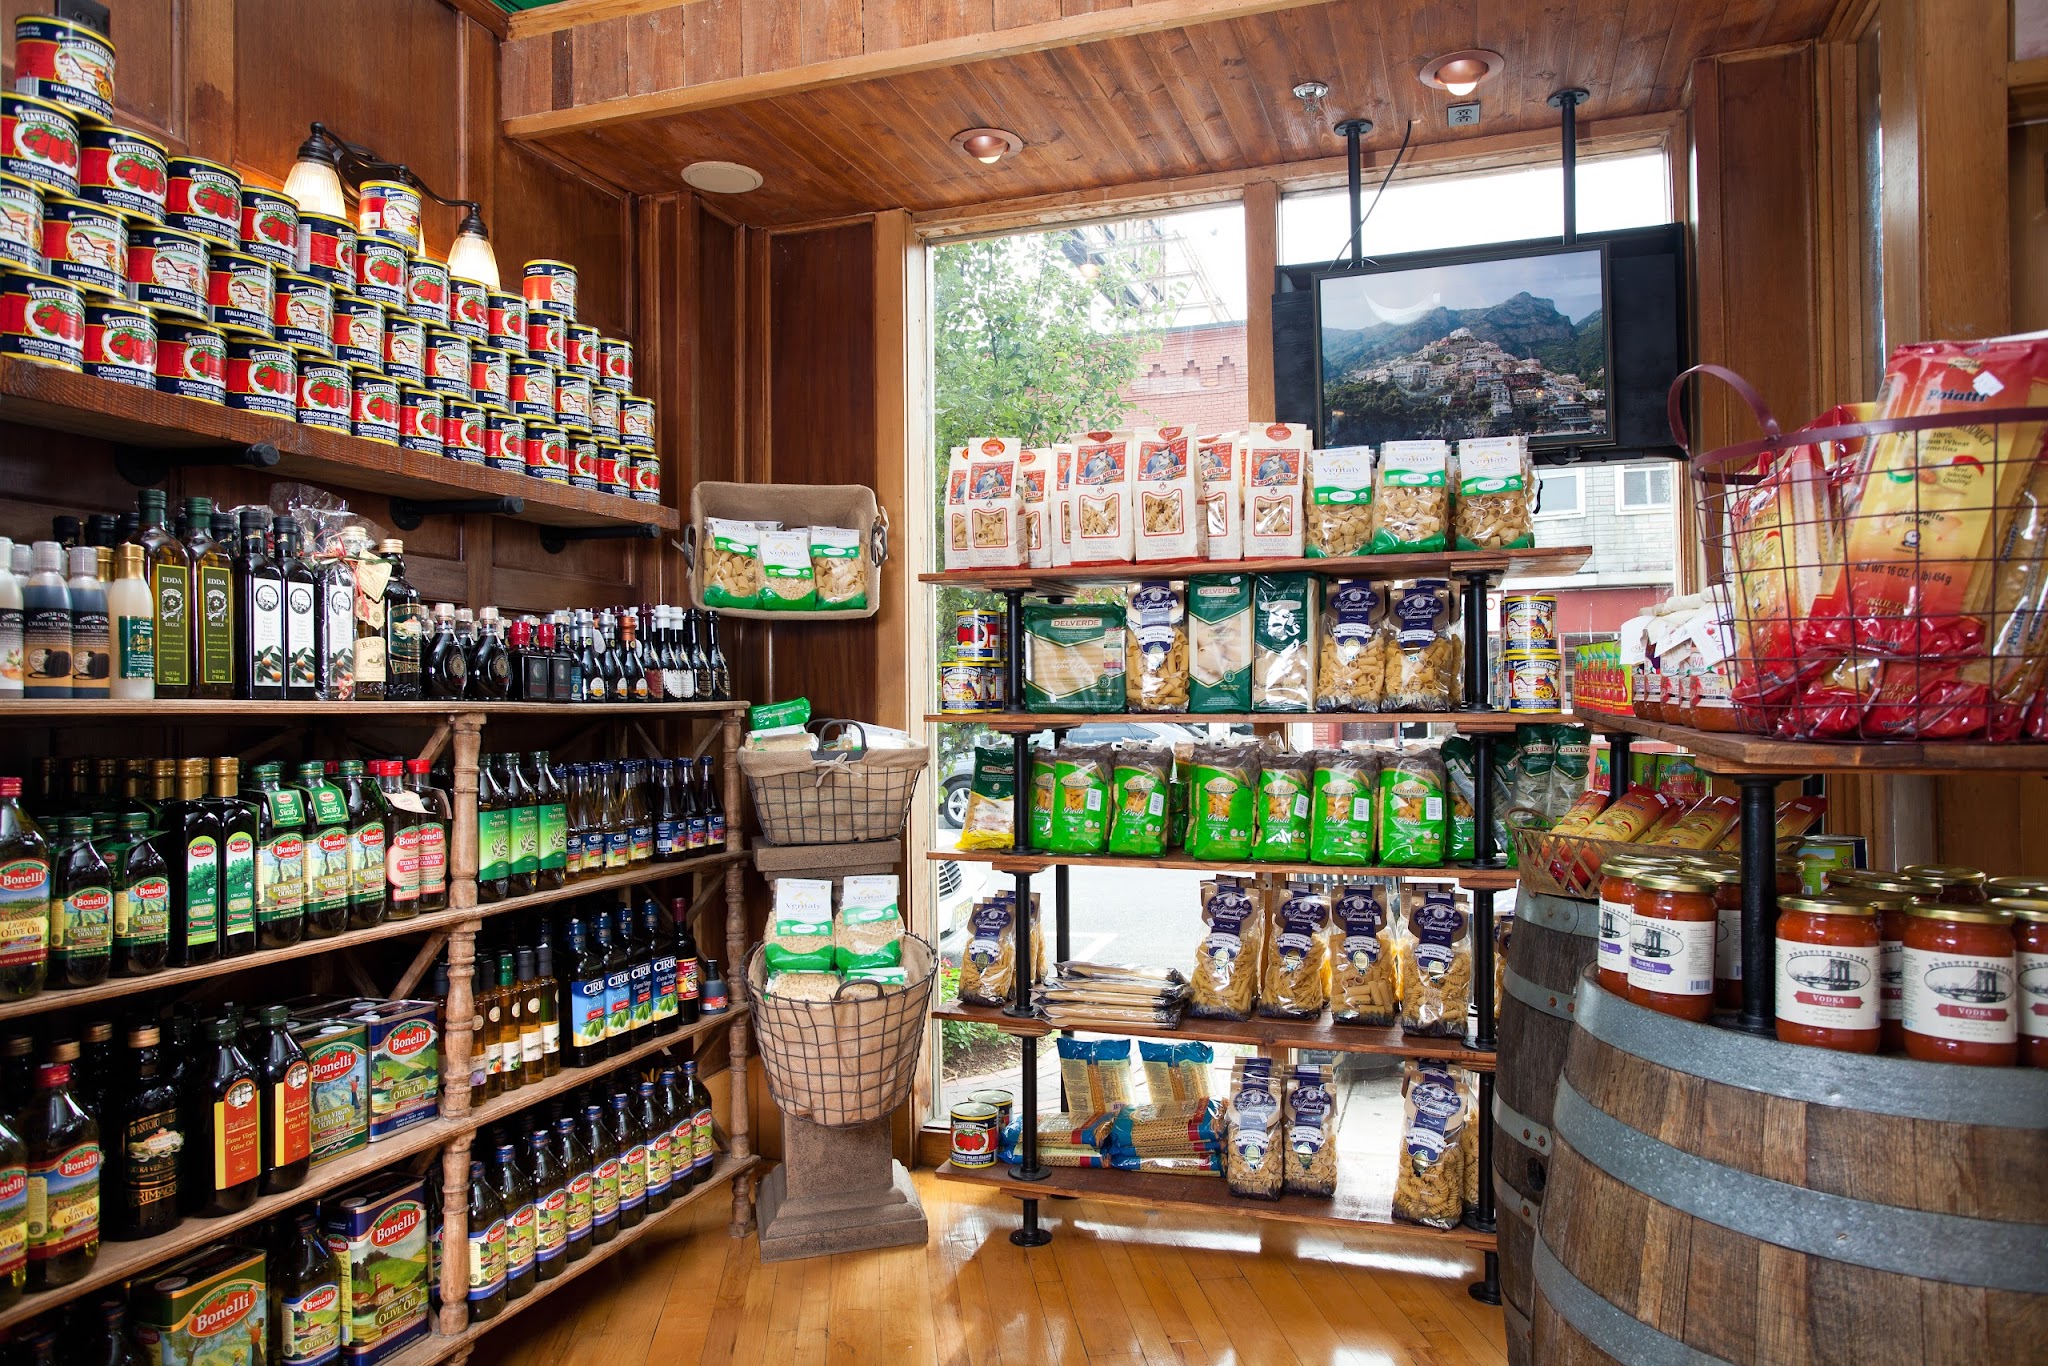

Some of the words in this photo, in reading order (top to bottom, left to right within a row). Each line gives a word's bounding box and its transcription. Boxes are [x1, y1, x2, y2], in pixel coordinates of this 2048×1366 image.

[20, 113, 70, 129] FRANCESCONI
[112, 144, 159, 161] FRANCESCONI
[8, 159, 51, 174] POMODORI
[193, 173, 235, 189] FRANCESCONI
[102, 189, 141, 203] POMODORI
[107, 200, 121, 208] PESO
[122, 203, 139, 212] NETTO
[62, 263, 91, 276] ITALIAN
[91, 268, 113, 280] PEELED
[148, 286, 174, 297] ITALIAN
[360, 286, 389, 297] POMODORI
[224, 309, 249, 320] ITALIAN
[24, 349, 39, 357] PESO
[40, 351, 59, 360] NETTO
[178, 380, 213, 391] POMODORI
[1926, 388, 1988, 402] Poiatti
[299, 410, 330, 420] POMODORI
[1956, 424, 1993, 447] RODUCT
[1944, 439, 1970, 447] Wheat
[1322, 466, 1361, 477] Veritaly
[162, 576, 182, 585] EDDA
[1855, 564, 1870, 573] NET
[1871, 565, 1884, 574] WT.
[1887, 566, 1896, 575] 16
[1932, 571, 1945, 582] 454
[1945, 575, 1952, 586] g
[207, 577, 226, 586] EDDA
[2007, 607, 2026, 646] Poiatti
[279, 806, 298, 818] Sicily
[322, 805, 341, 815] Sicily
[1062, 807, 1084, 815] Pasta
[1207, 814, 1230, 823] Pasta
[1266, 815, 1290, 824] Pasta
[1395, 817, 1421, 826] Pasta
[362, 831, 384, 841] Bonelli
[399, 836, 419, 846] Bonel
[231, 843, 249, 851] Bonelli
[323, 837, 347, 848] Bonelli
[192, 847, 212, 856] Bonelli
[276, 843, 302, 855] Bonelli
[3, 871, 44, 886] Bonelli
[139, 884, 166, 896] Bonelli
[230, 891, 249, 899] ORGANIC
[77, 896, 107, 907] Bonelli
[8, 921, 29, 930] LIGHT
[73, 927, 88, 935] EXTRA
[1, 928, 26, 938] OLIVE
[27, 926, 41, 935] OIL
[1789, 949, 1832, 958] BROOKLYN
[1636, 959, 1655, 968] NORMA
[1928, 961, 1979, 969] BROOKLYN
[1812, 994, 1845, 1004] VODKA
[1958, 1007, 1992, 1017] VODKA
[392, 1032, 427, 1051] Bonelli
[312, 1054, 352, 1078] Bonelli
[393, 1088, 412, 1100] OLIVE
[413, 1083, 425, 1093] OIL
[313, 1114, 330, 1125] EXTRA
[330, 1107, 351, 1119] VIRGIN
[318, 1120, 336, 1130] OLIVE
[336, 1114, 346, 1124] OIL
[288, 1122, 302, 1131] Olive
[226, 1136, 242, 1146] Extra
[243, 1130, 257, 1141] Virgin
[231, 1143, 246, 1152] Olive
[246, 1139, 255, 1147] Oil
[65, 1153, 98, 1174] Bonelli
[601, 1164, 617, 1177] Bonelli
[573, 1179, 591, 1191] Bonelli
[548, 1195, 565, 1209] Bonelli
[64, 1210, 85, 1223] OLIVE
[381, 1210, 396, 1221] Family
[516, 1211, 532, 1224] Bonelli
[376, 1212, 416, 1243] Bonelli
[328, 1239, 347, 1250] Bonelli
[204, 1291, 223, 1306] Family
[224, 1285, 248, 1293] Tradition
[306, 1293, 333, 1310] Bonelli
[399, 1293, 413, 1303] PURE
[196, 1294, 250, 1332] Bonelli
[379, 1306, 402, 1324] OLIVE
[403, 1296, 418, 1310] OIL
[304, 1339, 323, 1350] OLIVE
[324, 1332, 334, 1342] OIL
